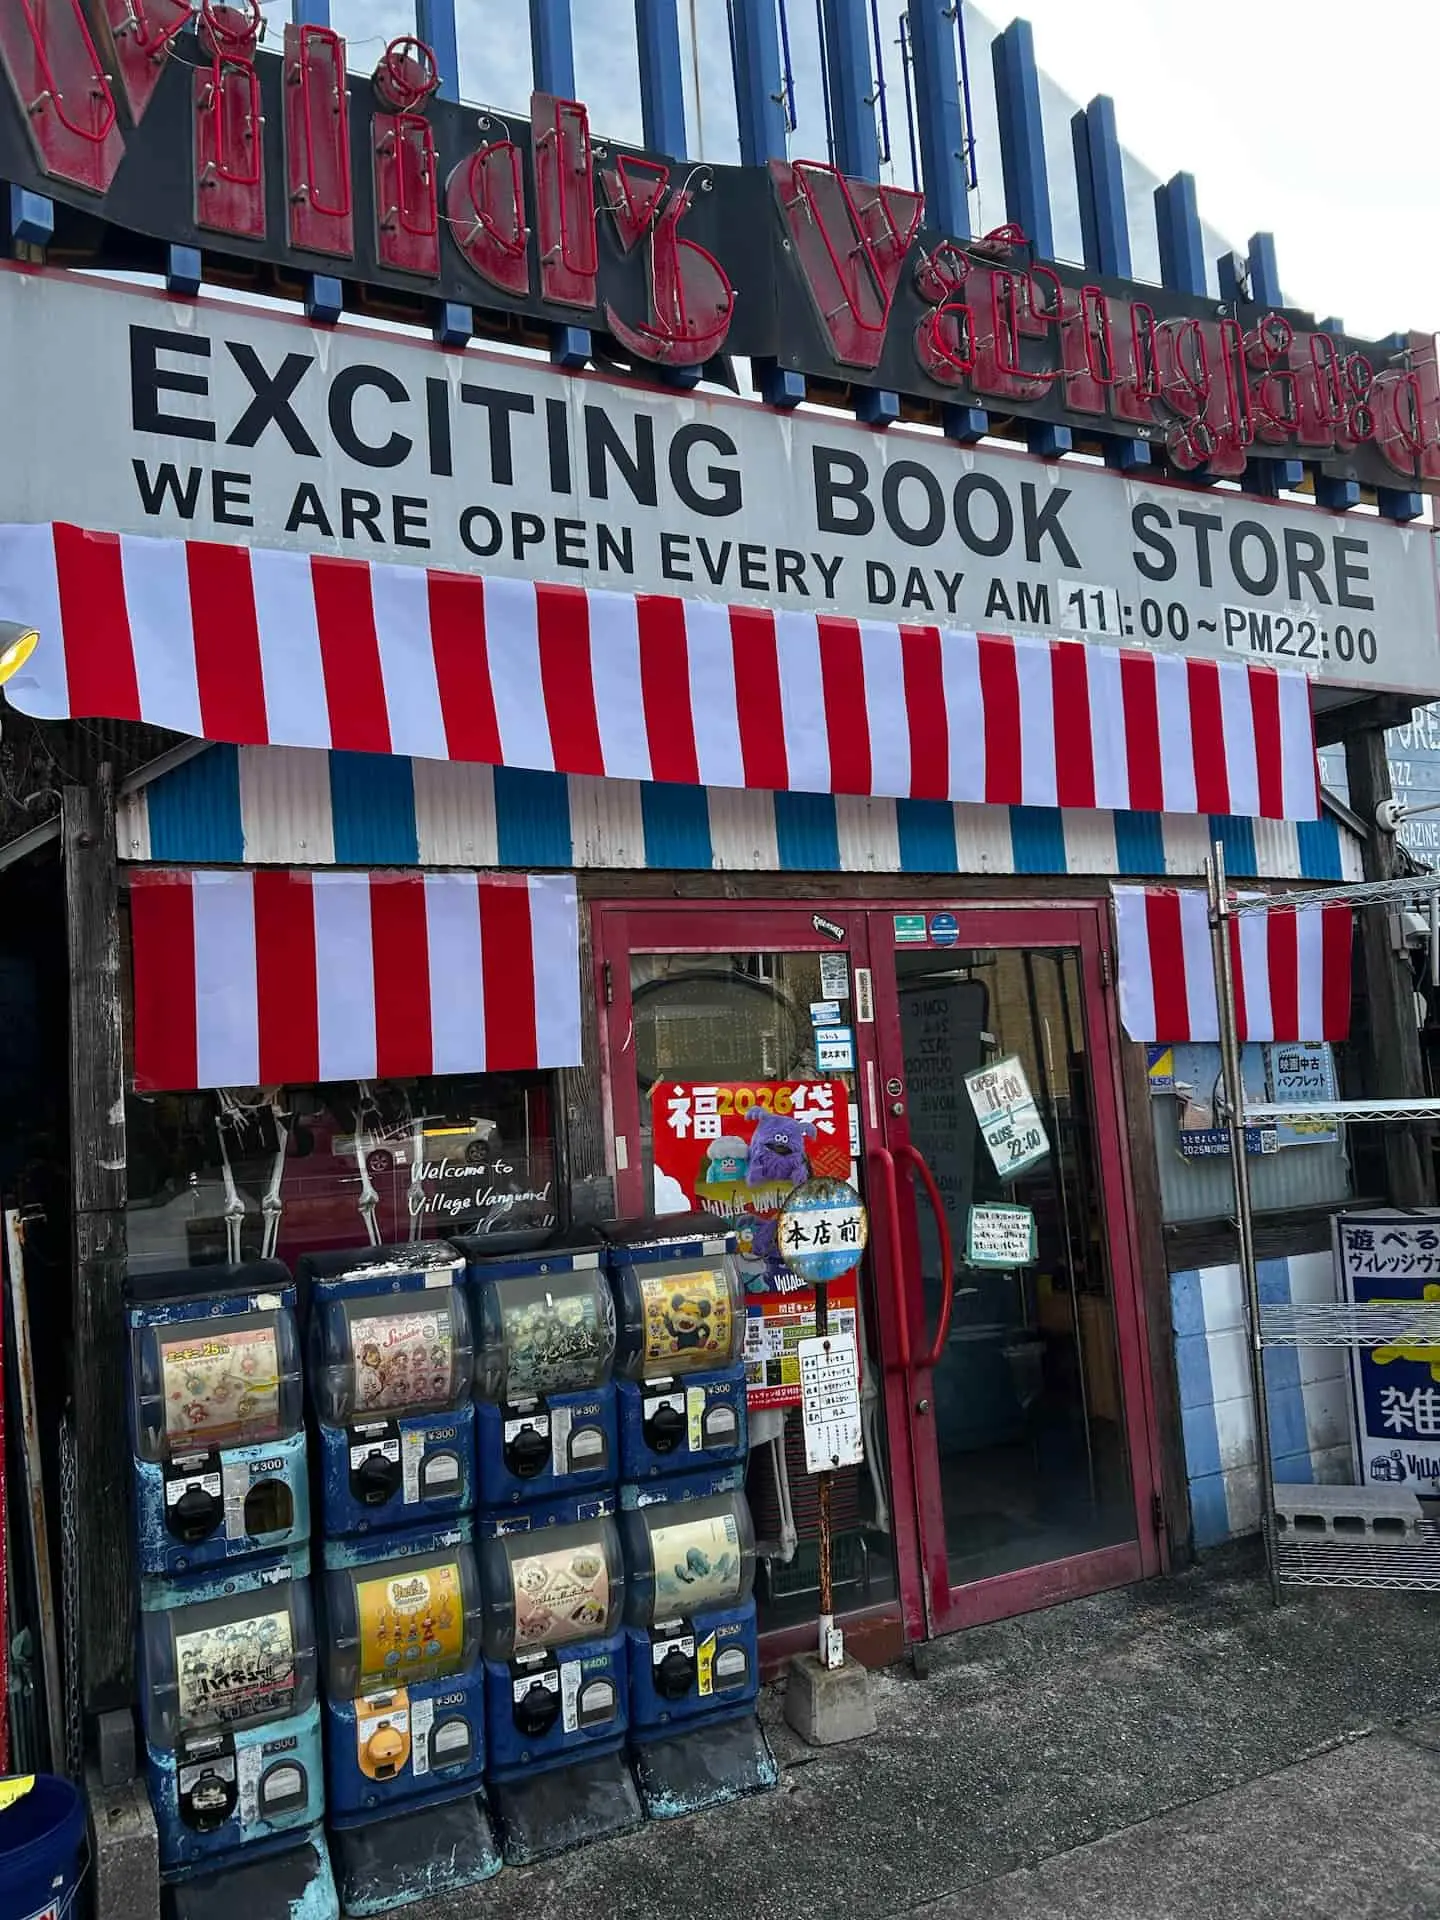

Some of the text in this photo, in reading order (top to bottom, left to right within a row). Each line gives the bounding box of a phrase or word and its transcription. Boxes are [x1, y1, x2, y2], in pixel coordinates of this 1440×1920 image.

[130, 324, 1375, 611] EXCITING BOOK STORE
[131, 458, 255, 527] WE
[285, 483, 431, 549] ARE
[459, 505, 634, 574] OPEN
[661, 531, 844, 600] EVERY
[866, 559, 964, 615] DAY
[984, 577, 1051, 625] AM
[1277, 1073, 1326, 1088] パンフレット
[716, 1086, 794, 1116] 2026
[1007, 1128, 1041, 1161] 22:00
[411, 1157, 514, 1181] Welcome to
[409, 1181, 551, 1216] Village Vanguard
[786, 1215, 860, 1250] 本店前
[1346, 1228, 1440, 1251] 遊べる
[1406, 1453, 1440, 1481] VILLA
